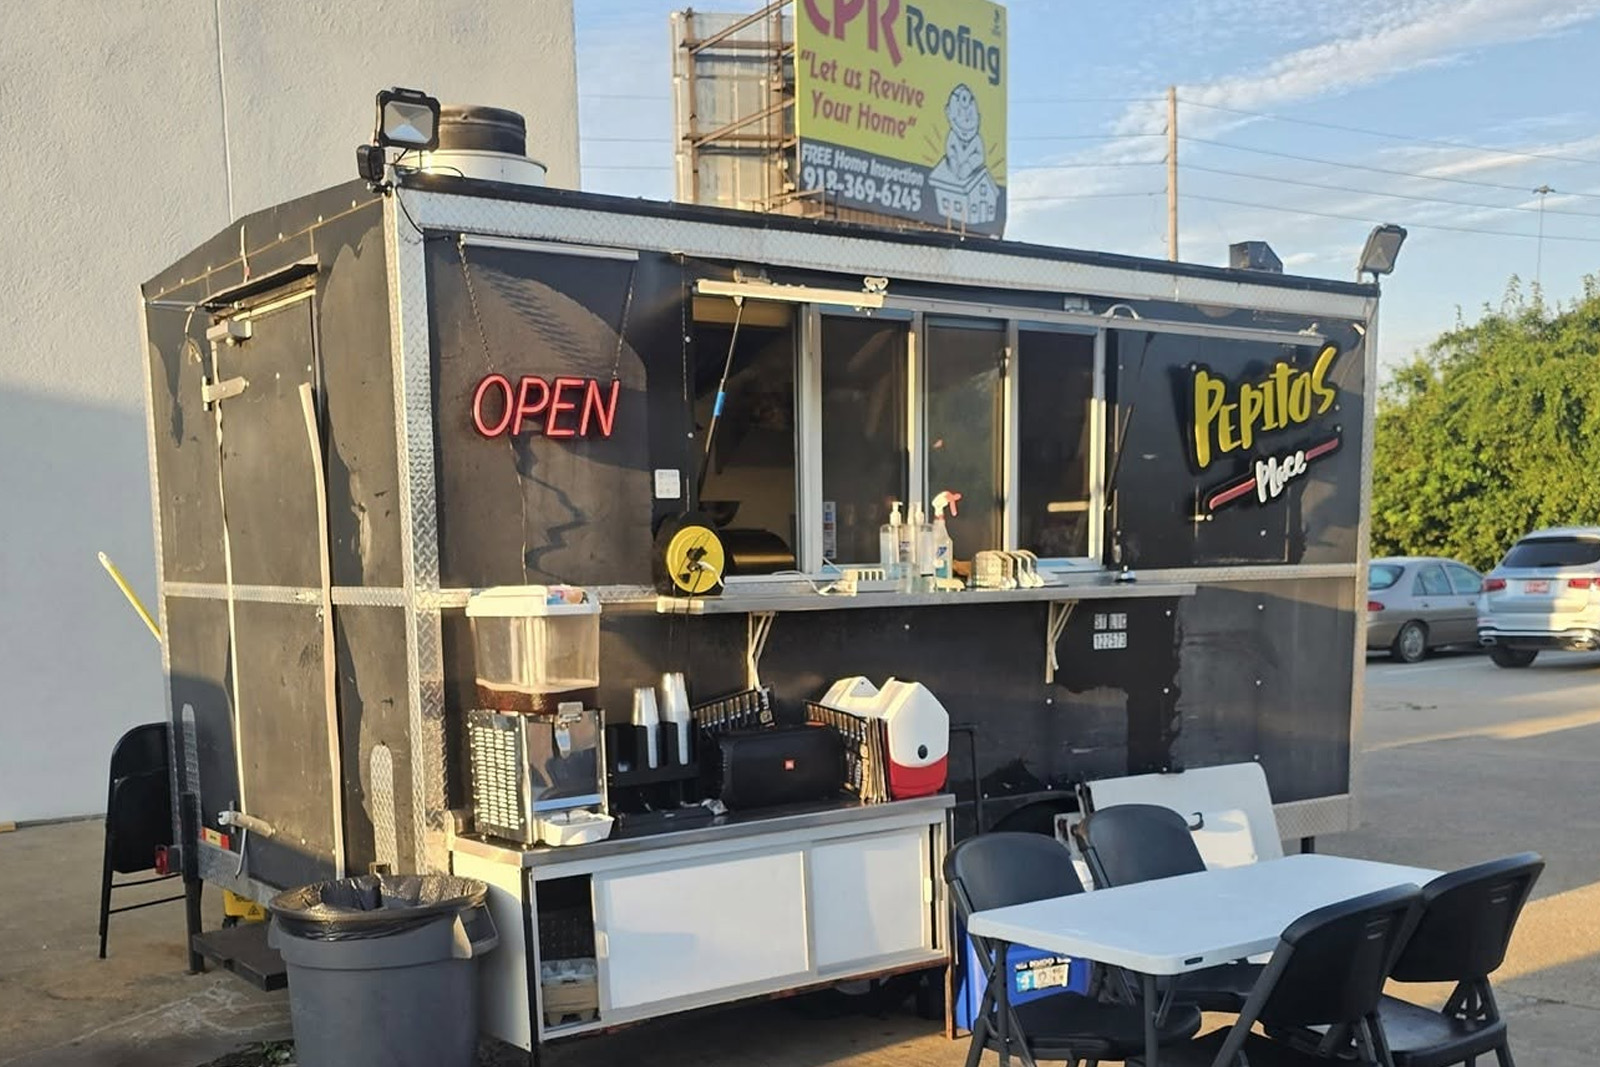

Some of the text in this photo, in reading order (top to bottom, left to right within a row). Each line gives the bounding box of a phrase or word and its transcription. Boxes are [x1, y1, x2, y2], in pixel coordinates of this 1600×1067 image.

[906, 4, 1000, 87] Roofing
[811, 89, 852, 124] Your
[844, 67, 862, 90] us
[868, 68, 925, 109] Revive
[802, 143, 833, 167] FREE
[834, 150, 869, 174] Home
[472, 373, 621, 437] OPEN
[1256, 450, 1307, 503] Place
